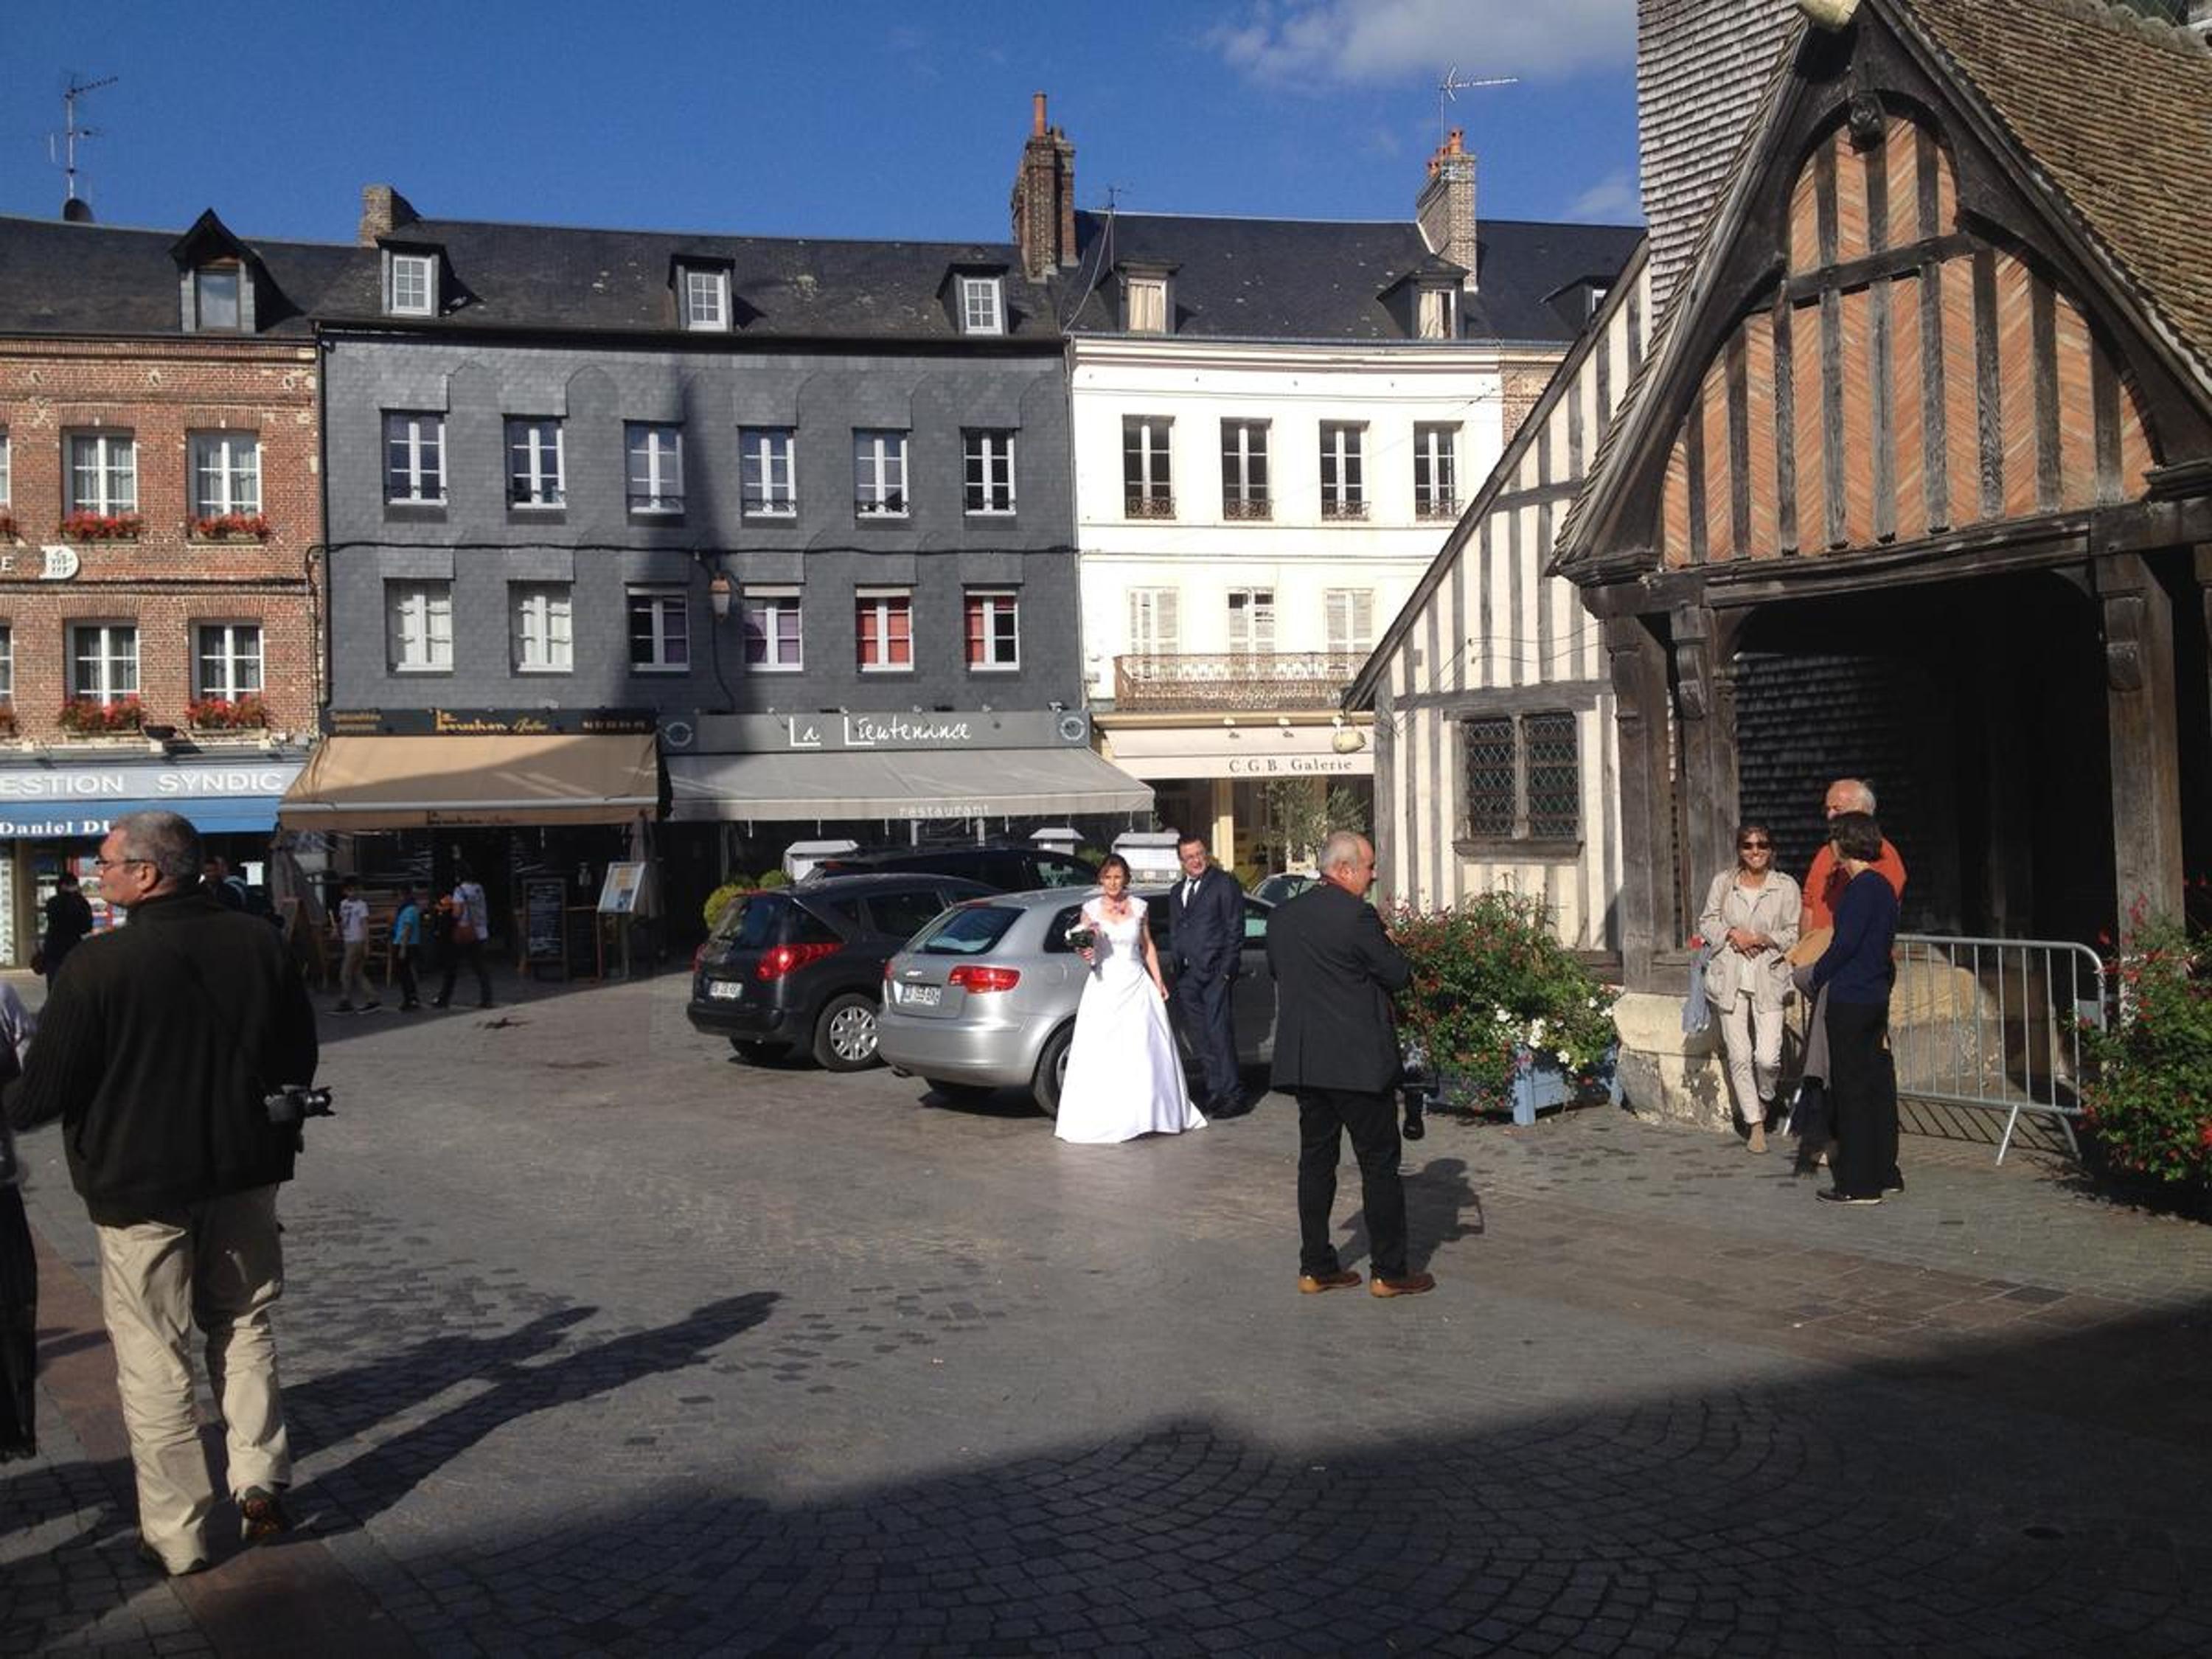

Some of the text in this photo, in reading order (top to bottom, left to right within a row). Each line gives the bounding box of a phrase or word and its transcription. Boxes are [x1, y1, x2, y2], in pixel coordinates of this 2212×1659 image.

[789, 716, 821, 747] La
[1291, 757, 1353, 771] Galerie
[158, 771, 283, 793] SYNDIC
[0, 821, 73, 834] Daniel
